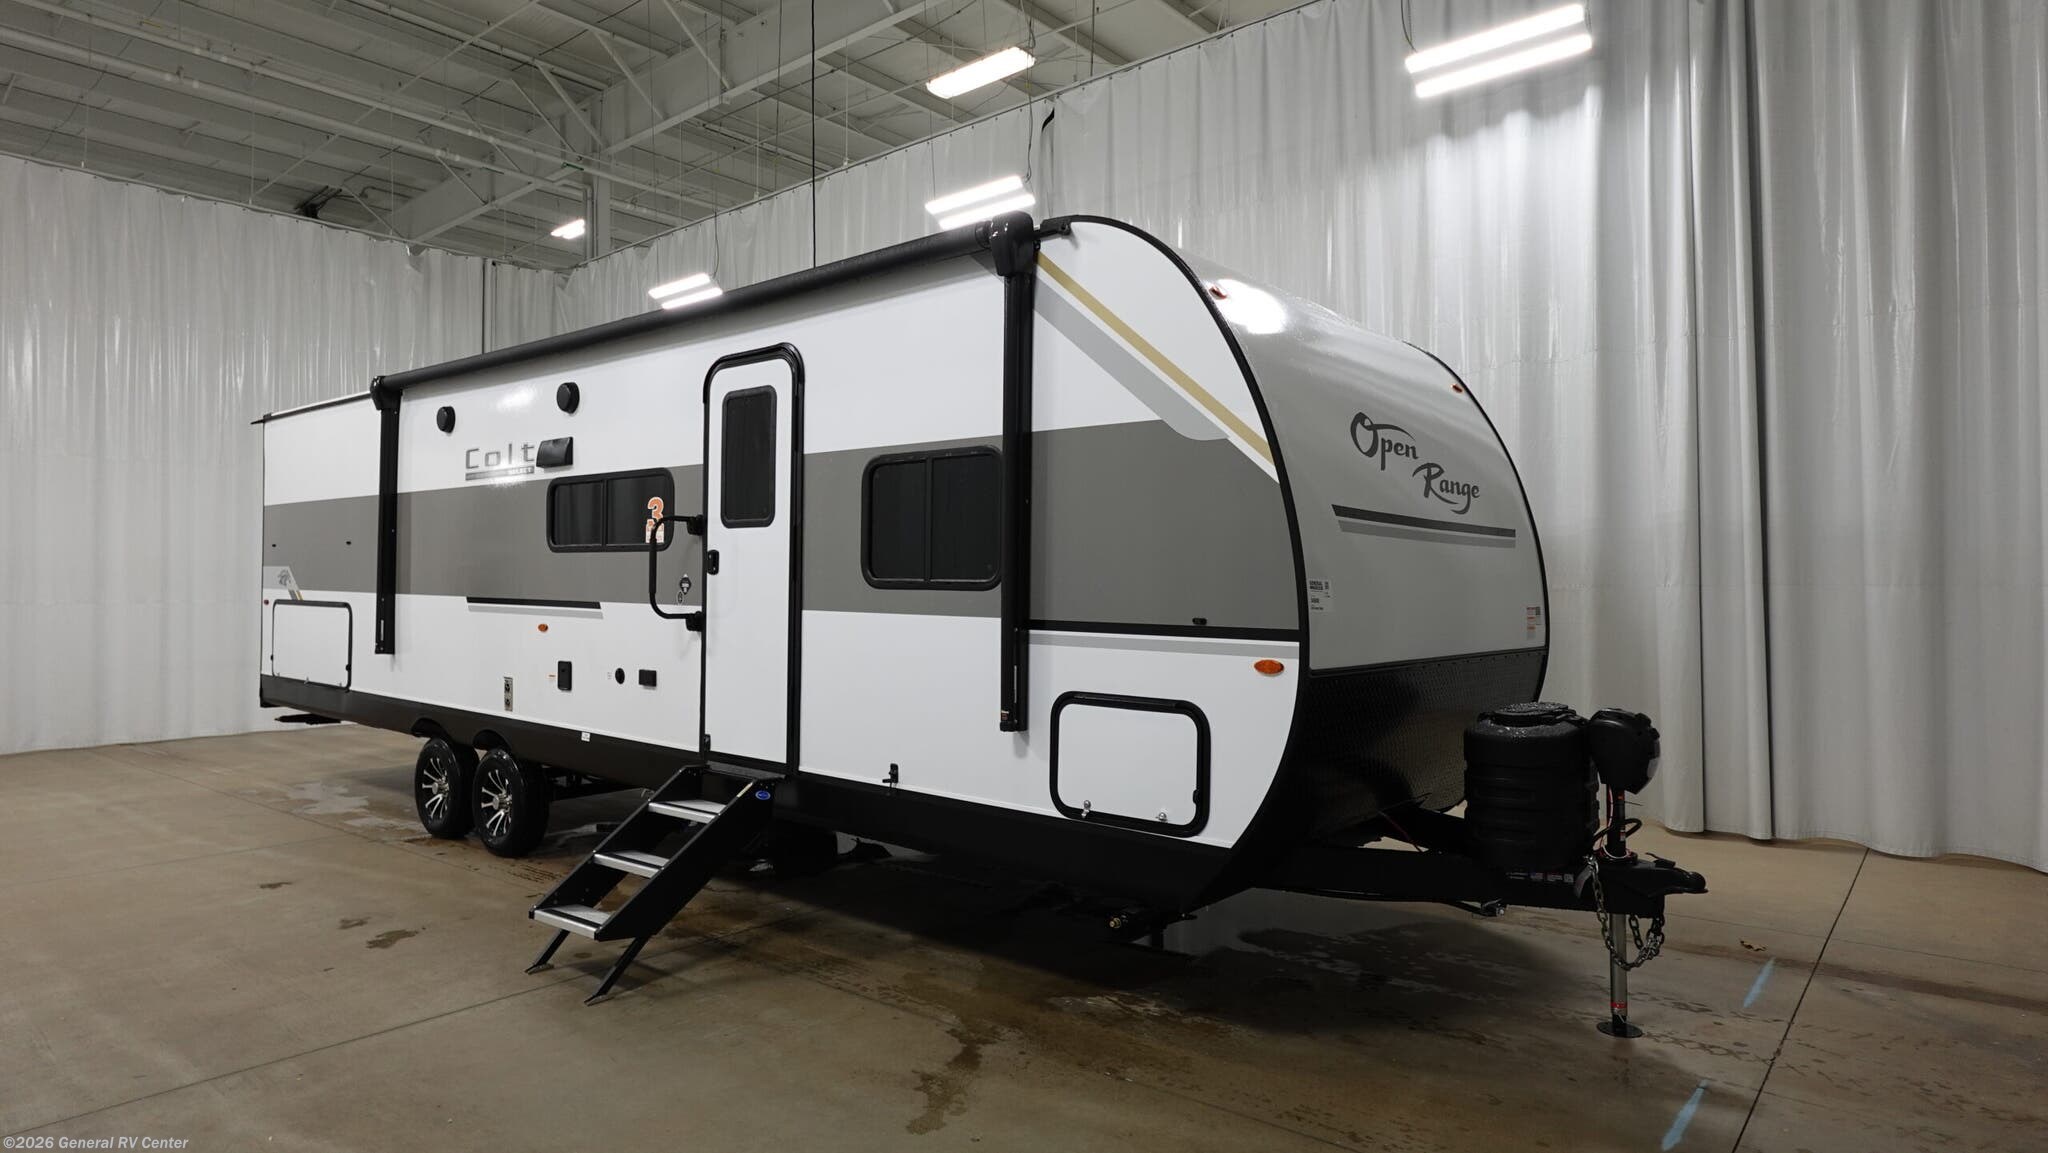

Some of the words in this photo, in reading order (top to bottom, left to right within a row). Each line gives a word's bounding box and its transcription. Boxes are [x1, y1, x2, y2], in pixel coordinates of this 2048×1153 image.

[466, 443, 535, 469] Colt
[1350, 411, 1419, 471] Open
[1412, 462, 1481, 515] Range
